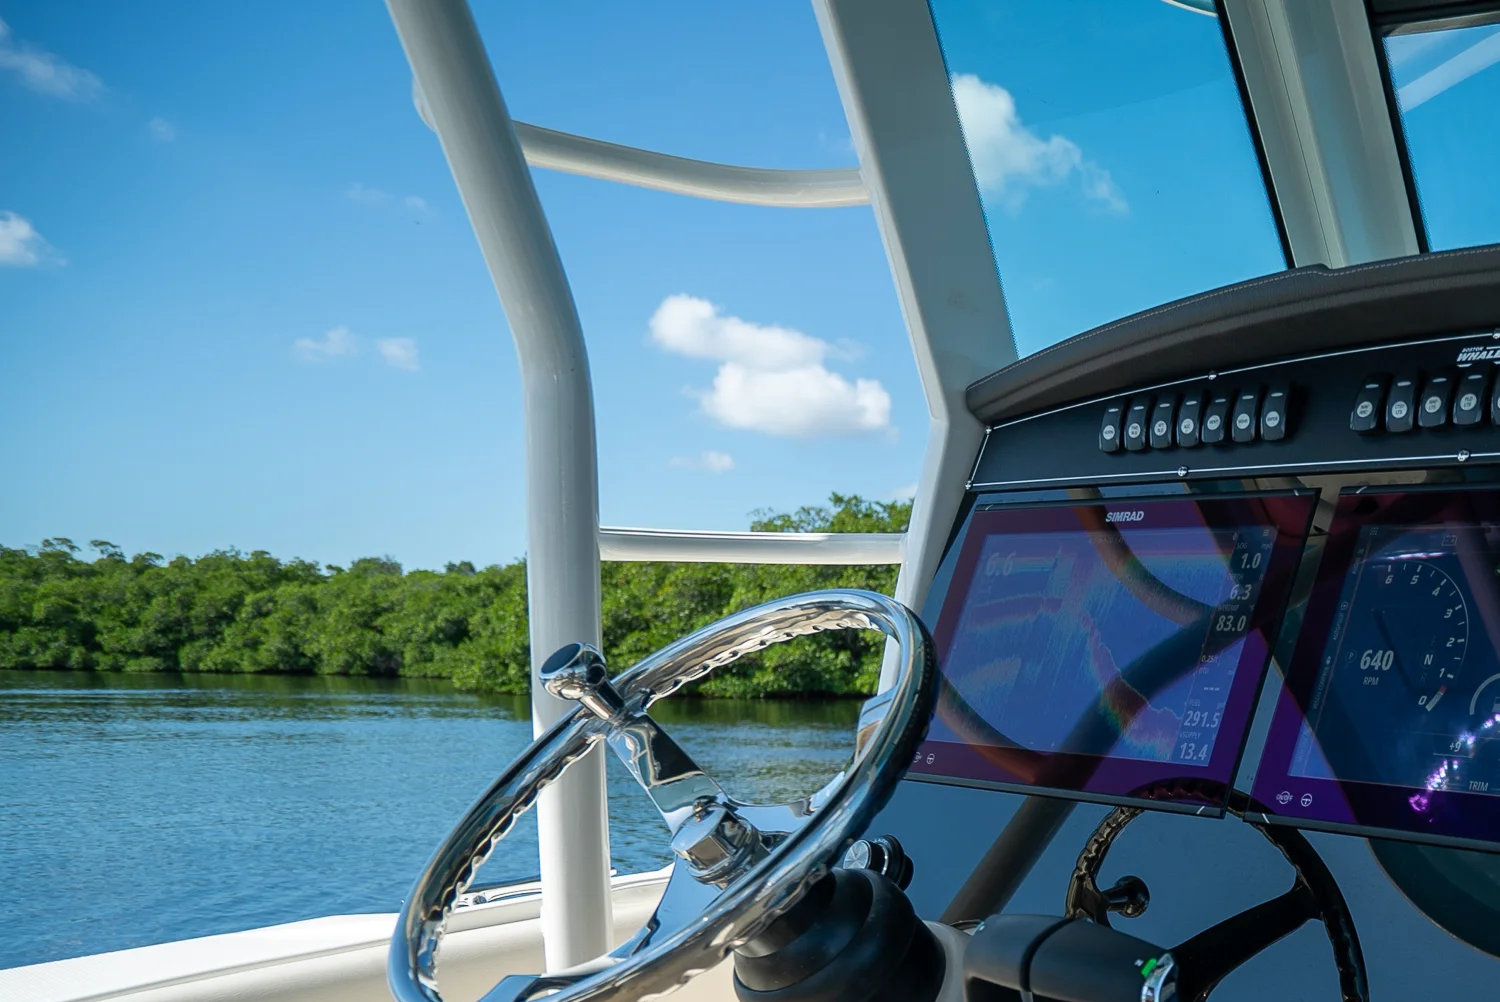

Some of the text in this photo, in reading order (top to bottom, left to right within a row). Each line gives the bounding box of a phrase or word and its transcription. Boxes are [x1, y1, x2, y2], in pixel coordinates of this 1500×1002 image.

[1105, 510, 1145, 523] SIMRAD
[985, 551, 1017, 577] 6.6
[1240, 552, 1262, 570] 1.0
[1385, 575, 1394, 585] 6
[1410, 575, 1420, 585] 5
[1229, 583, 1252, 601] 6.3
[1431, 587, 1441, 597] 4
[1443, 609, 1454, 619] 3
[1215, 615, 1247, 632] 83.0
[1446, 638, 1456, 648] 2
[1359, 649, 1395, 671] 640
[1423, 653, 1434, 666] N
[1439, 667, 1446, 679] 1
[1362, 677, 1380, 687] RPM
[1417, 695, 1427, 706] 0
[1183, 710, 1220, 728] 291.5
[1179, 742, 1209, 761] 13.4
[1469, 781, 1489, 791] TRIM
